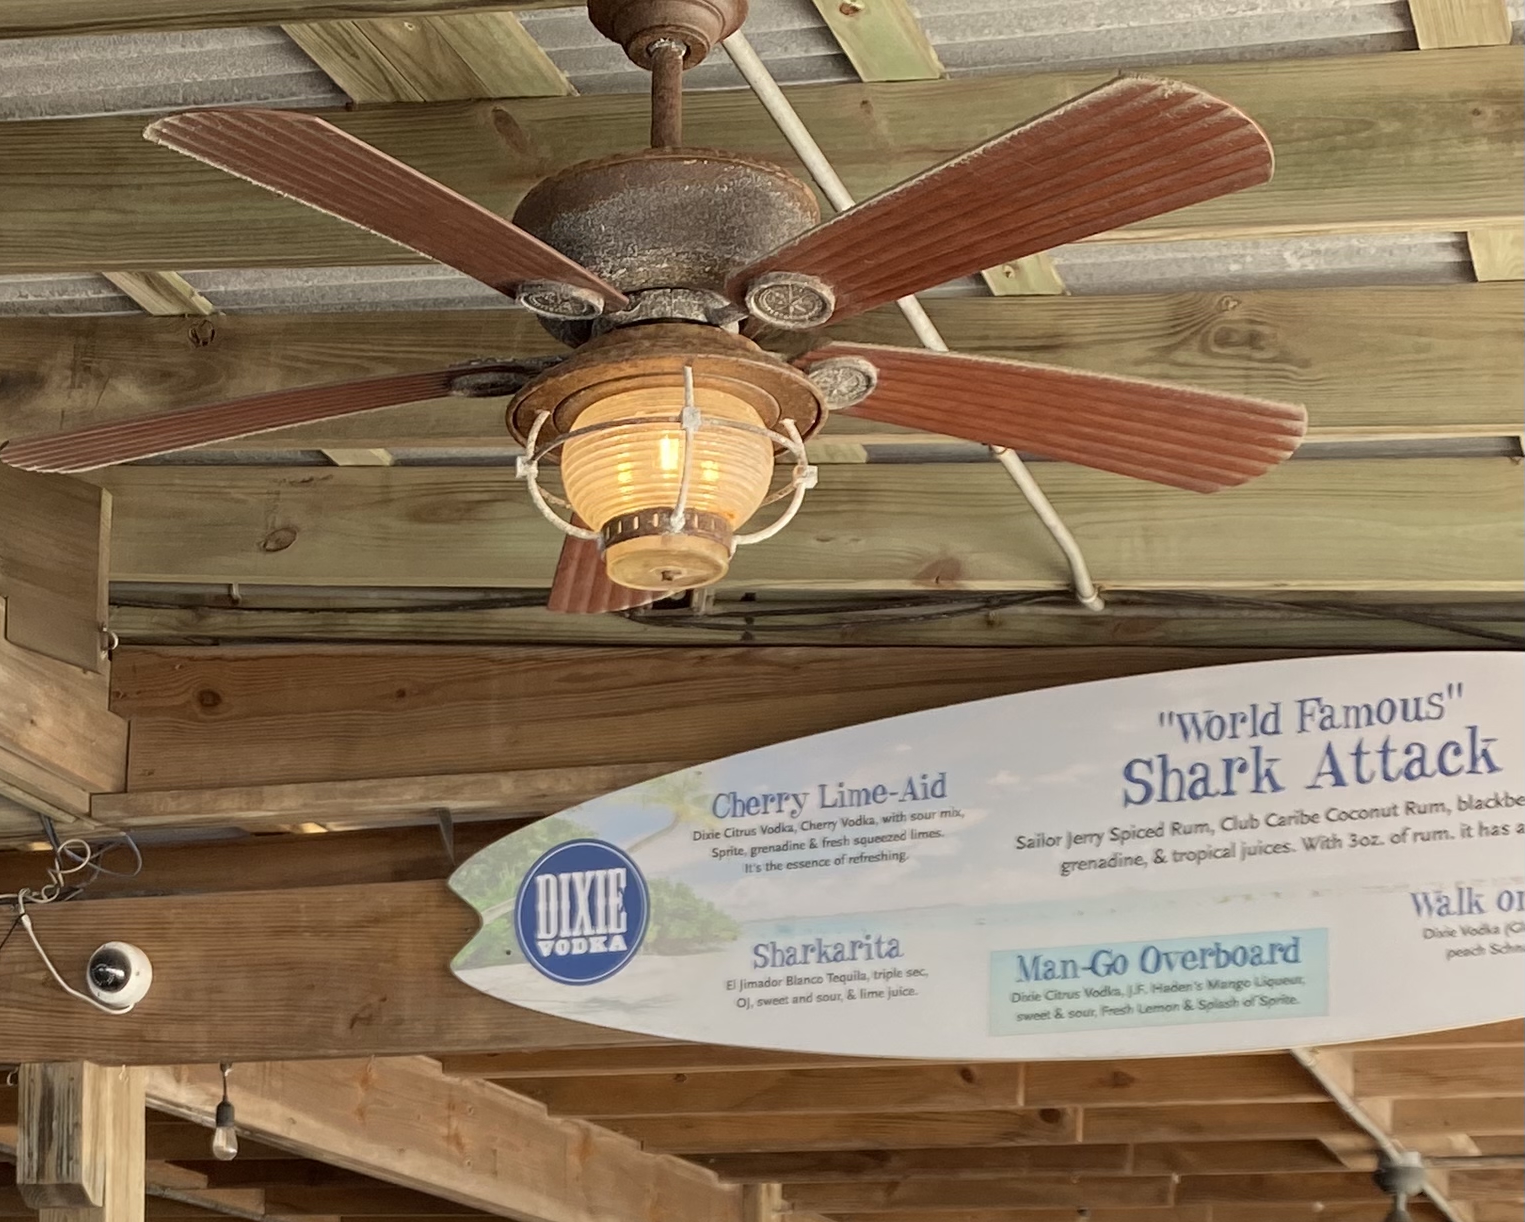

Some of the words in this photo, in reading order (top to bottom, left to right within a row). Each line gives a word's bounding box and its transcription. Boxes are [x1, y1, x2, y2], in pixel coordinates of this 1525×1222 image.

[1158, 702, 1282, 744] "World
[1295, 682, 1463, 734] Famous"
[1123, 745, 1286, 807] Shark
[1305, 725, 1504, 789] Attack
[712, 792, 809, 819] Cherry
[819, 772, 947, 809] Lime-Aid
[693, 829, 721, 841] Dixie
[724, 826, 757, 838] Citrus
[760, 822, 798, 836] Vodka,
[800, 819, 838, 833] Cherry
[841, 815, 878, 829] Vodka,
[882, 811, 907, 824] with
[910, 810, 936, 822] sour
[940, 806, 965, 820] mix,
[1016, 832, 1063, 850] Sailor
[1067, 830, 1104, 849] Jerry
[1110, 821, 1164, 844] Spiced
[1170, 820, 1215, 837] Rum,
[1221, 813, 1260, 832] Club
[1265, 809, 1320, 828] Caribe
[1325, 803, 1399, 822] Coconut
[1405, 801, 1452, 816] Rum,
[711, 845, 748, 859] Sprite,
[750, 840, 806, 858] grenadine
[809, 838, 819, 849] &
[822, 835, 850, 848] fresh
[853, 832, 907, 848] squeezed
[910, 828, 945, 841] limes.
[1061, 852, 1148, 877] grenadine,
[1154, 849, 1168, 865] &
[1172, 843, 1236, 865] tropical
[1240, 840, 1296, 861] juices.
[1302, 833, 1342, 852] With
[1348, 833, 1384, 847] 3oz.
[1390, 827, 1411, 845] of
[1413, 830, 1454, 842] rum.
[1460, 823, 1472, 839] it
[1478, 821, 1508, 837] has
[745, 863, 762, 874] It's
[765, 860, 783, 872] the
[786, 857, 831, 870] essence
[834, 854, 846, 866] of
[536, 867, 627, 940] DIXIE
[1410, 887, 1486, 918] Walk
[537, 934, 628, 957] VODKA
[1459, 923, 1500, 937] Vodka
[753, 934, 904, 970] Sharkarita
[1015, 949, 1129, 982] Man-Go
[1139, 937, 1302, 975] Overboard
[1446, 945, 1486, 961] peach
[726, 979, 737, 991] El
[739, 976, 782, 992] Jimador
[786, 973, 824, 987] Blanco
[827, 969, 870, 985] Tequila,
[874, 967, 903, 982] triple
[906, 967, 929, 979] sec,
[1011, 992, 1042, 1003] Dixie
[1044, 988, 1080, 1001] Citrus
[1083, 985, 1124, 999] Vodka,
[1207, 979, 1251, 992] Mango
[757, 994, 789, 1007] sweet
[792, 991, 813, 1005] and
[816, 991, 843, 1003] sour,
[846, 989, 856, 1000] &
[860, 987, 885, 1000] lime
[887, 985, 919, 1001] juice.
[1016, 1010, 1050, 1022] sweet
[1054, 1007, 1064, 1019] &
[1068, 1007, 1097, 1019] sour,
[1101, 1004, 1134, 1016] Fresh
[1138, 1002, 1179, 1014] Lemon
[1183, 999, 1194, 1011] &
[1198, 996, 1239, 1012] Splash
[1242, 995, 1258, 1007] of
[1260, 993, 1300, 1008] Sprite.
